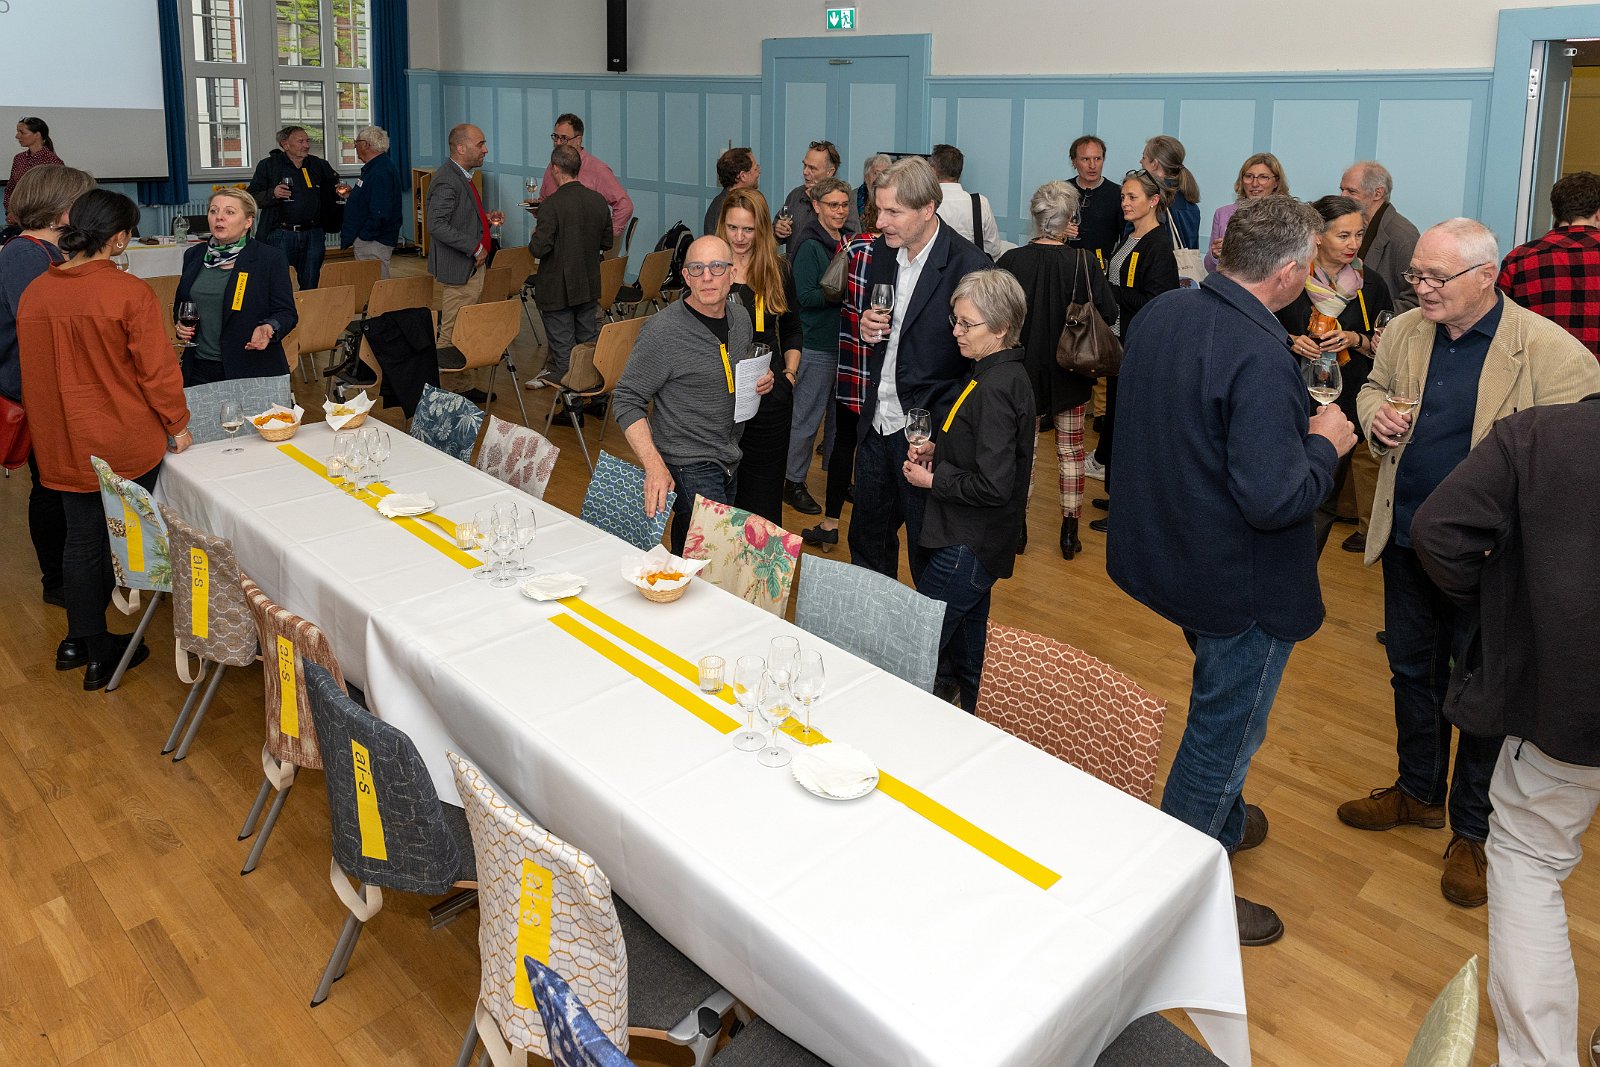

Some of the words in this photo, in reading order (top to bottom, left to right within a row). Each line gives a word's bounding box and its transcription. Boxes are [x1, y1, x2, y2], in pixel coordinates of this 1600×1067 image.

[193, 555, 206, 587] ai-s
[280, 644, 292, 682] ai-s
[355, 751, 370, 794] ai-s
[523, 873, 548, 926] ai-s
